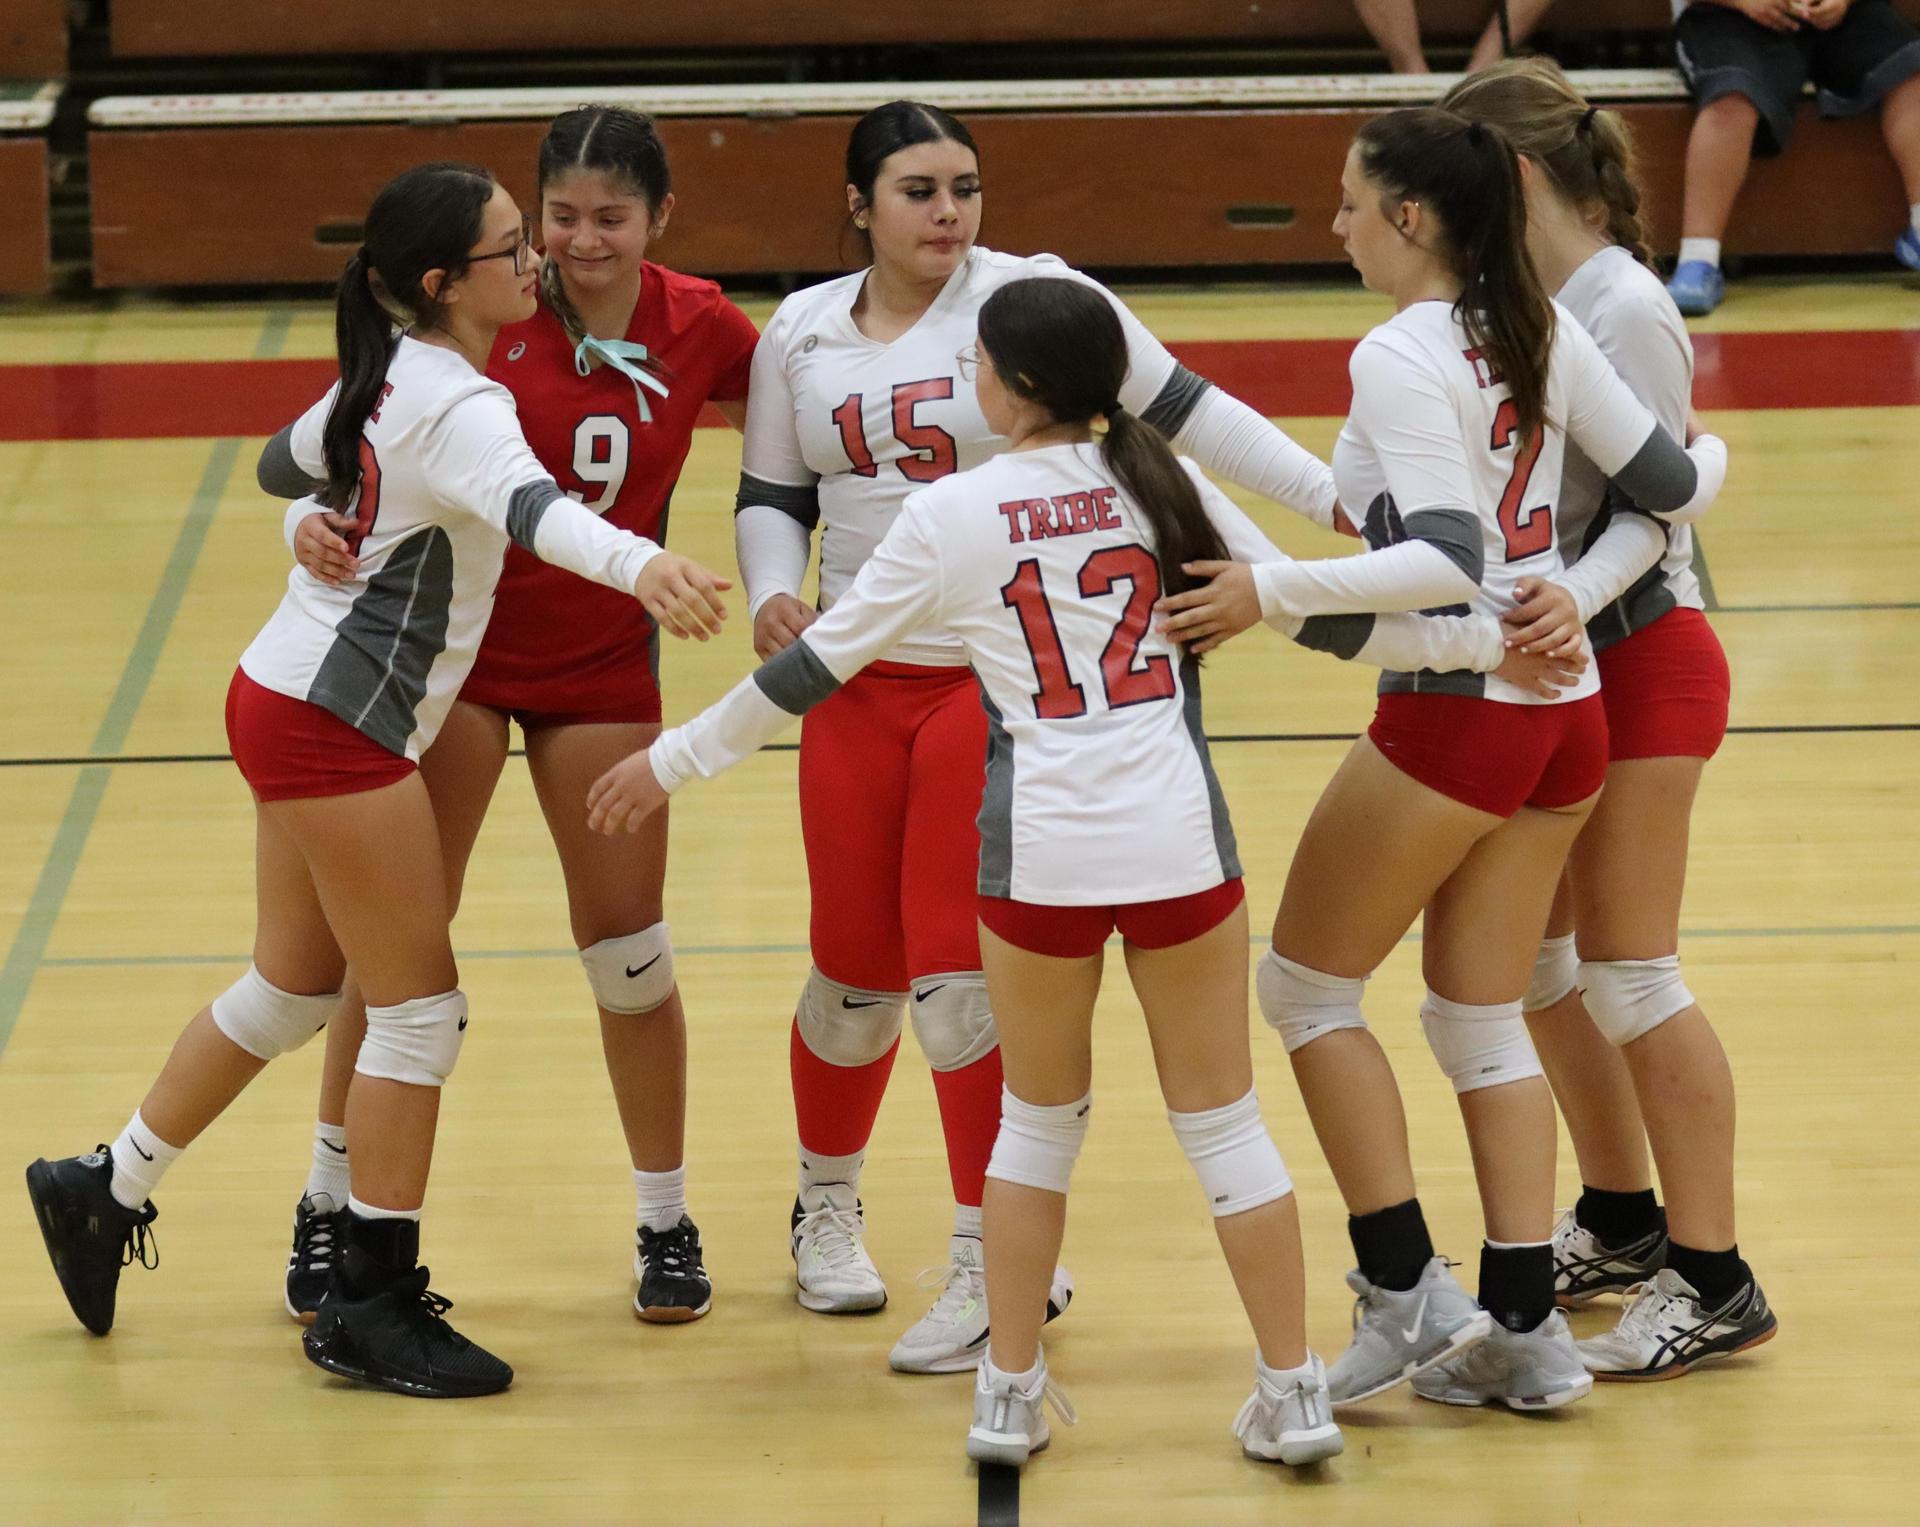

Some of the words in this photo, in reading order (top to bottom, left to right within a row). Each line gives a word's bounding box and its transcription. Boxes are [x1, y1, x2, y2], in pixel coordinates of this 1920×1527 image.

[565, 413, 631, 517] 9
[831, 376, 958, 484] 15
[1490, 397, 1552, 563] 2
[998, 486, 1122, 544] TRIBE
[1000, 542, 1177, 720] 12
